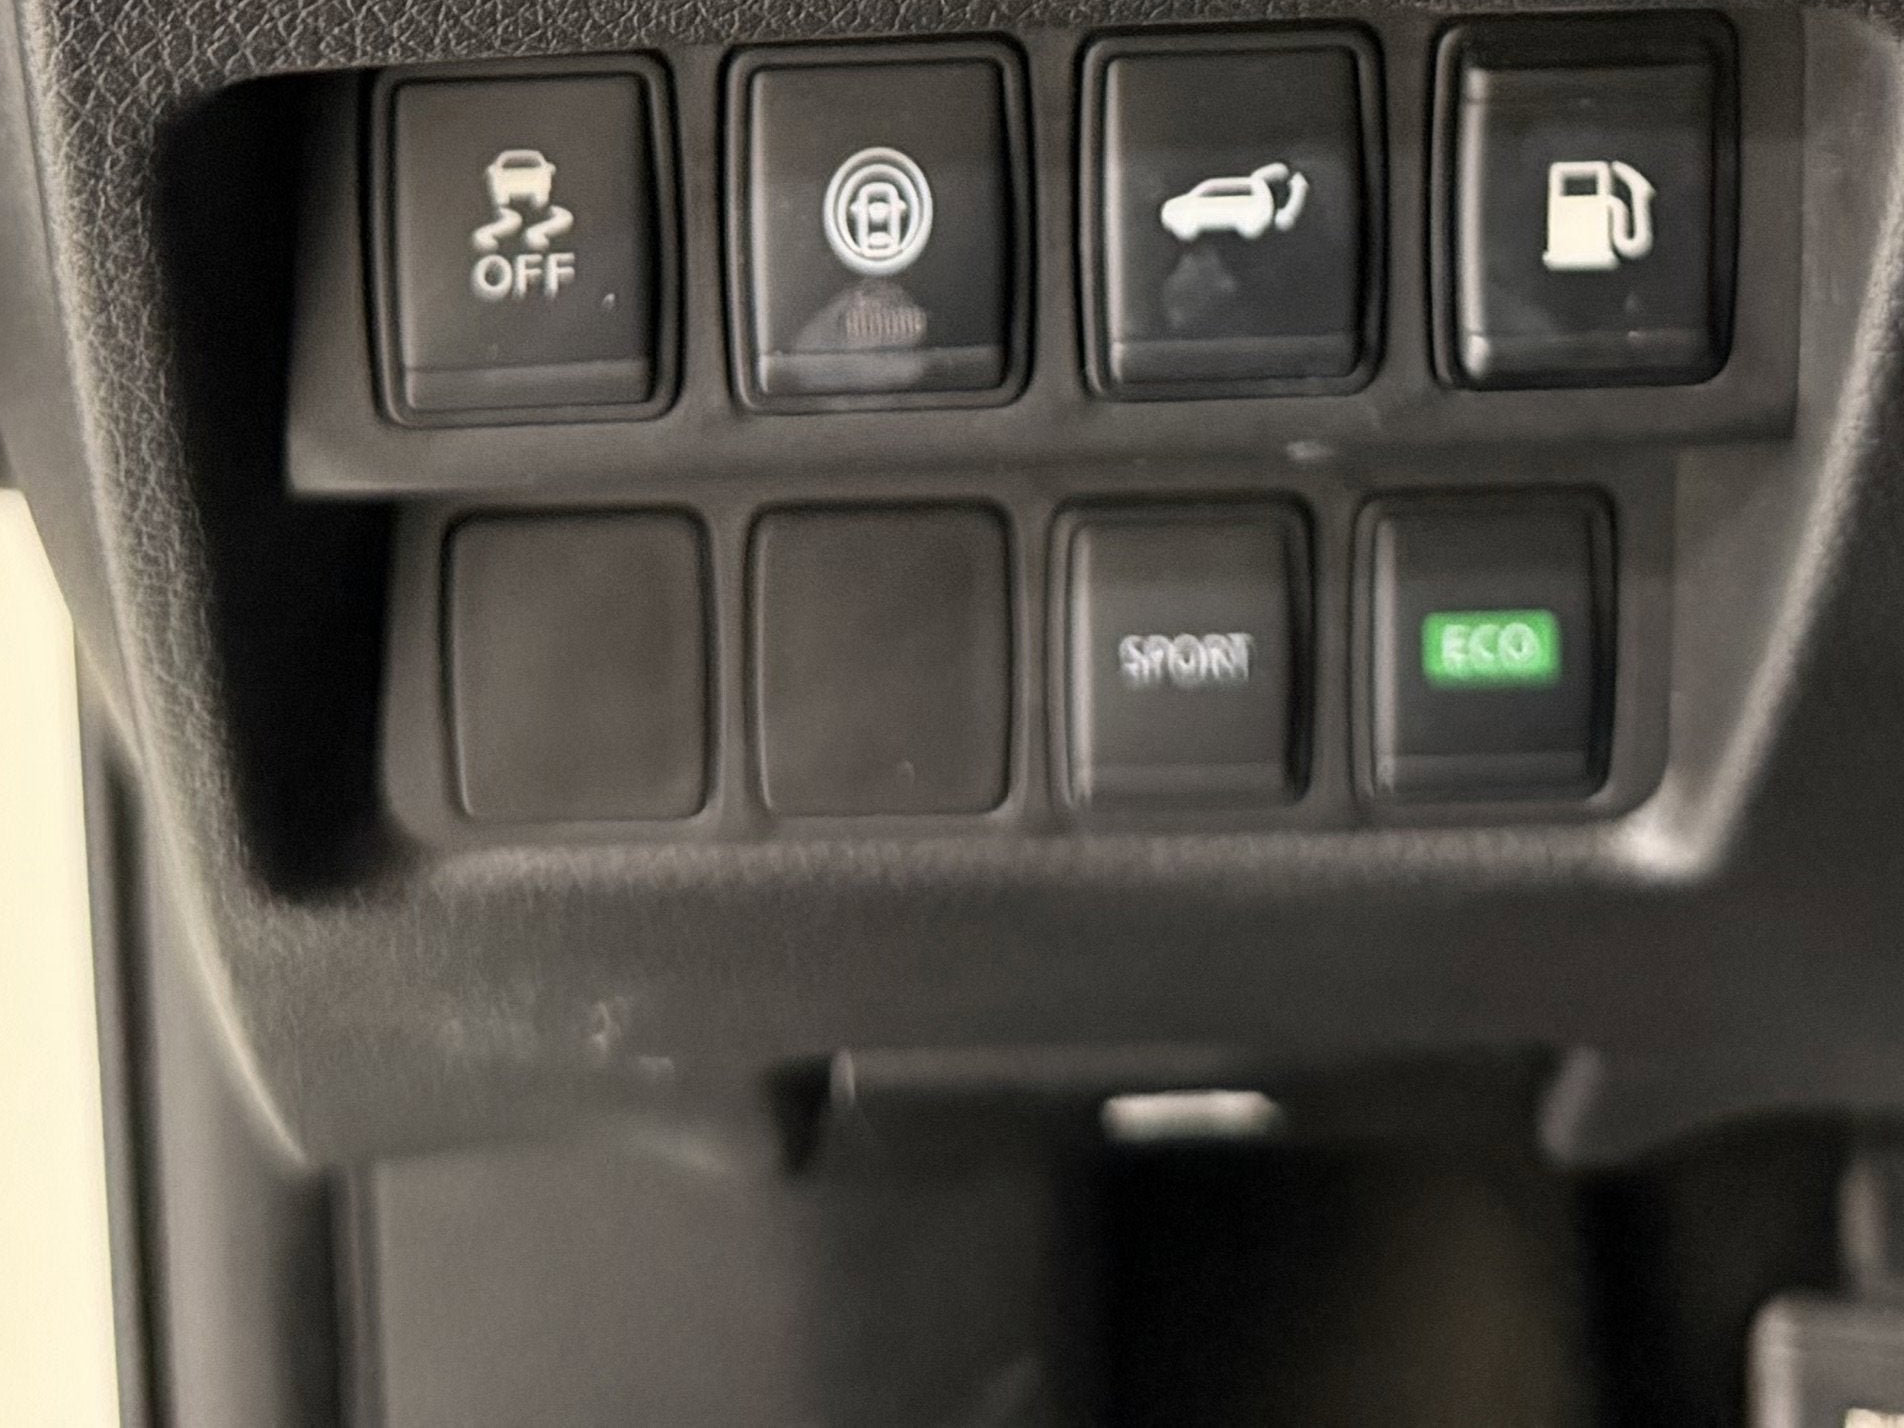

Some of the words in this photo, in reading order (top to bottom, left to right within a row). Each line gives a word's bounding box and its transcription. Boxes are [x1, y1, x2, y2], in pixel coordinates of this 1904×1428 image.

[473, 253, 575, 300] OFF
[1118, 632, 1255, 688] SPORT
[1441, 622, 1540, 678] ECO
